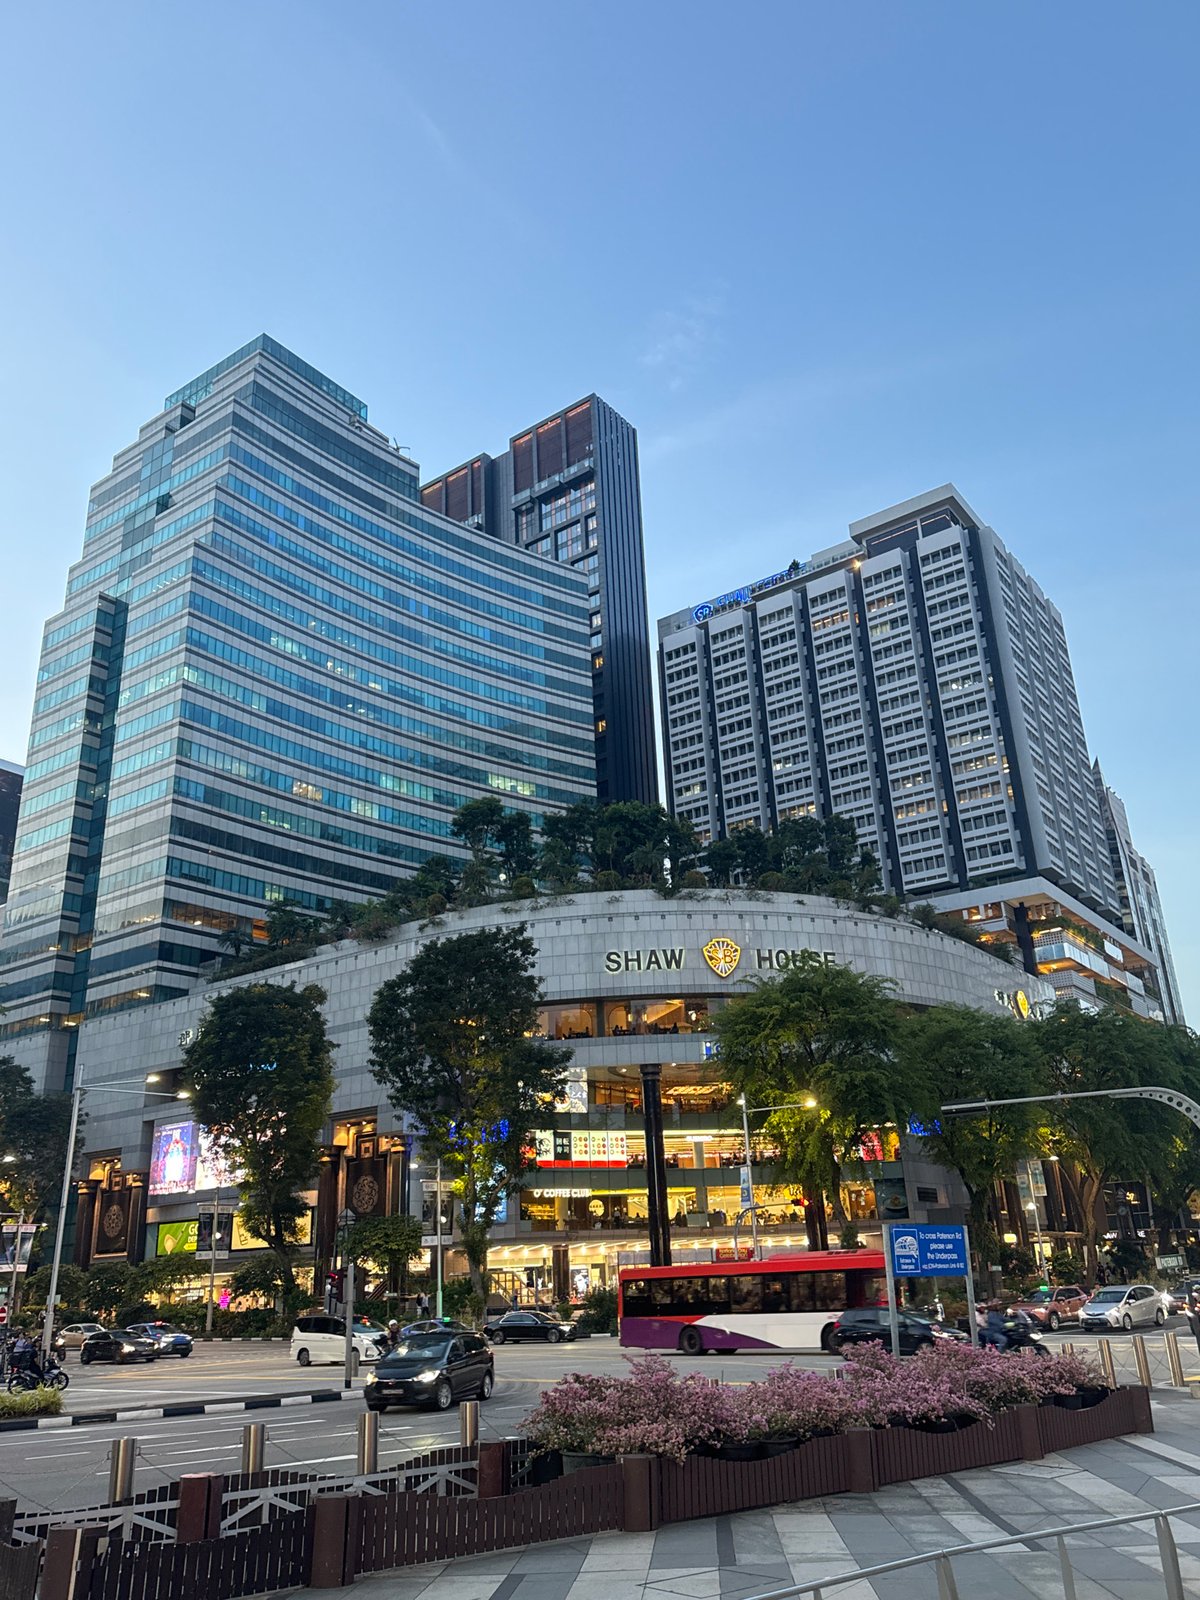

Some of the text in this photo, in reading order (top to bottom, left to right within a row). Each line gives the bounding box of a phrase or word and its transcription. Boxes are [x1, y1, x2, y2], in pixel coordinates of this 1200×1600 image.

[604, 948, 685, 973] SHAW
[543, 1188, 571, 1198] COFFEE
[919, 1231, 925, 1239] To
[930, 1242, 945, 1251] please
